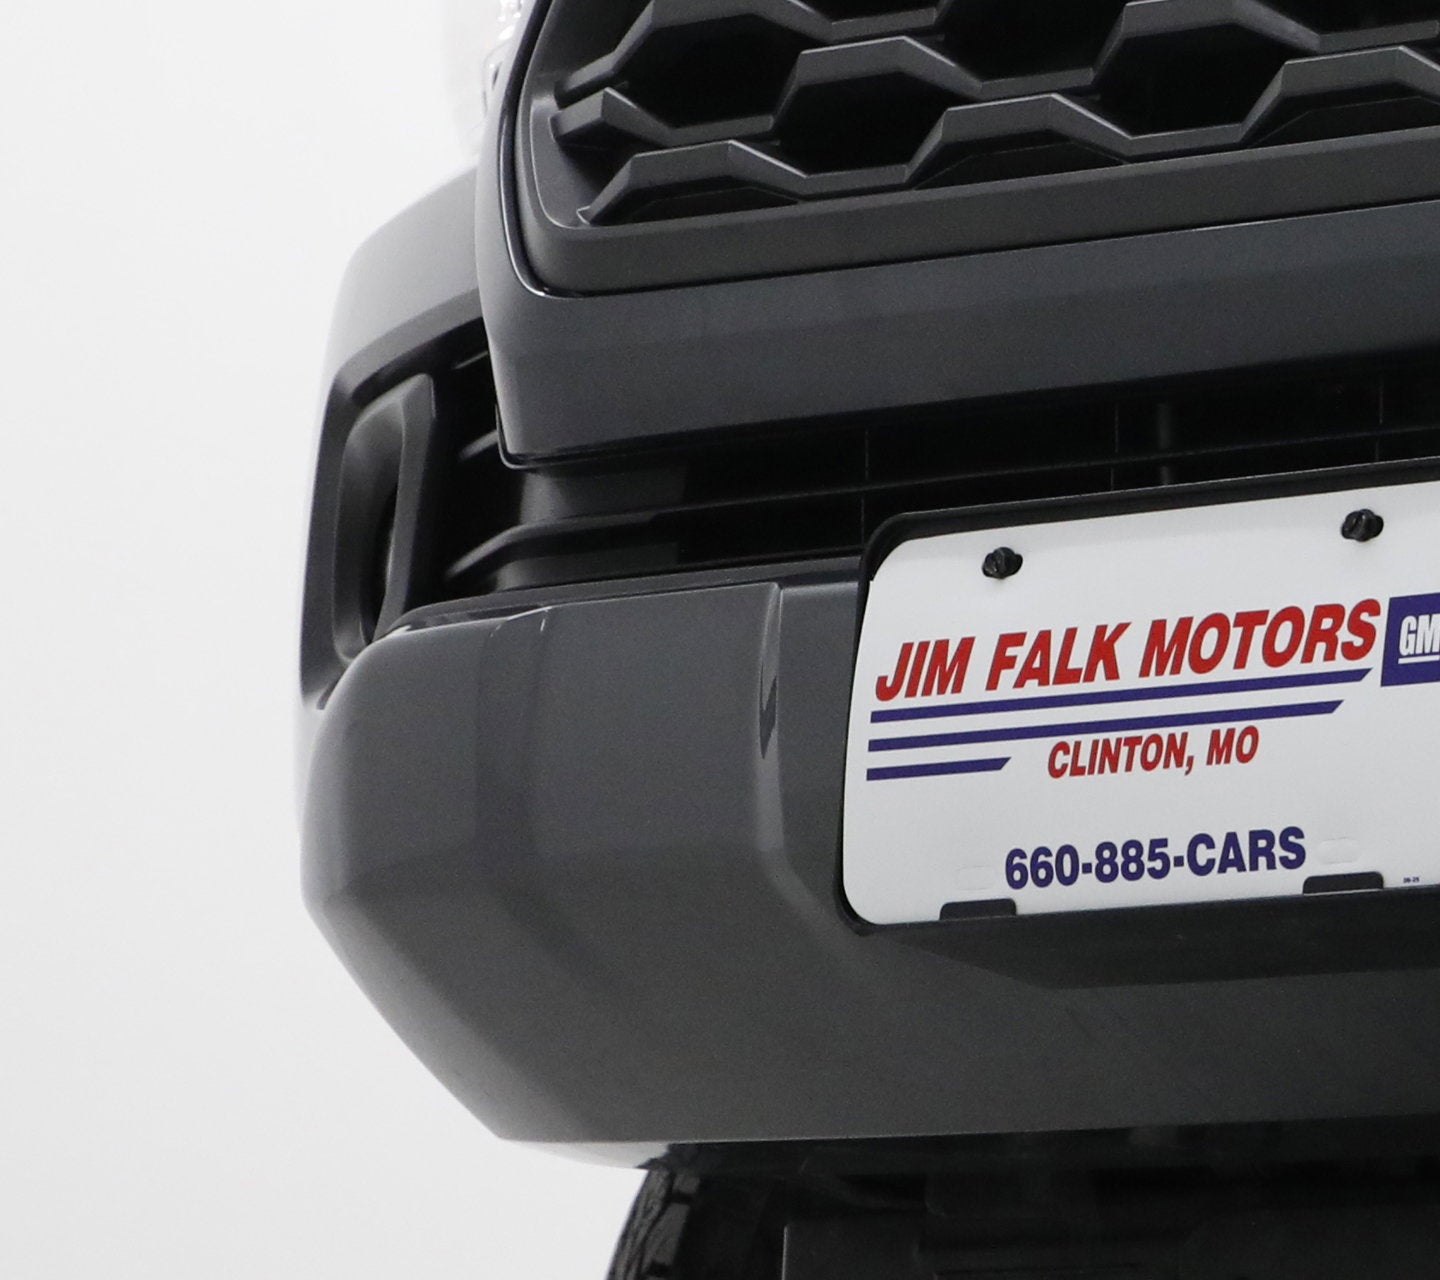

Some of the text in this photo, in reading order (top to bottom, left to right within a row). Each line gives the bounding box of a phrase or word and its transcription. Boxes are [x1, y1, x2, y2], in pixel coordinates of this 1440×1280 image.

[876, 598, 1382, 702] JIM FALK MOTORS
[1048, 725, 1260, 779] CLINTON, MO
[1005, 826, 1307, 890] 660-885-CARS
